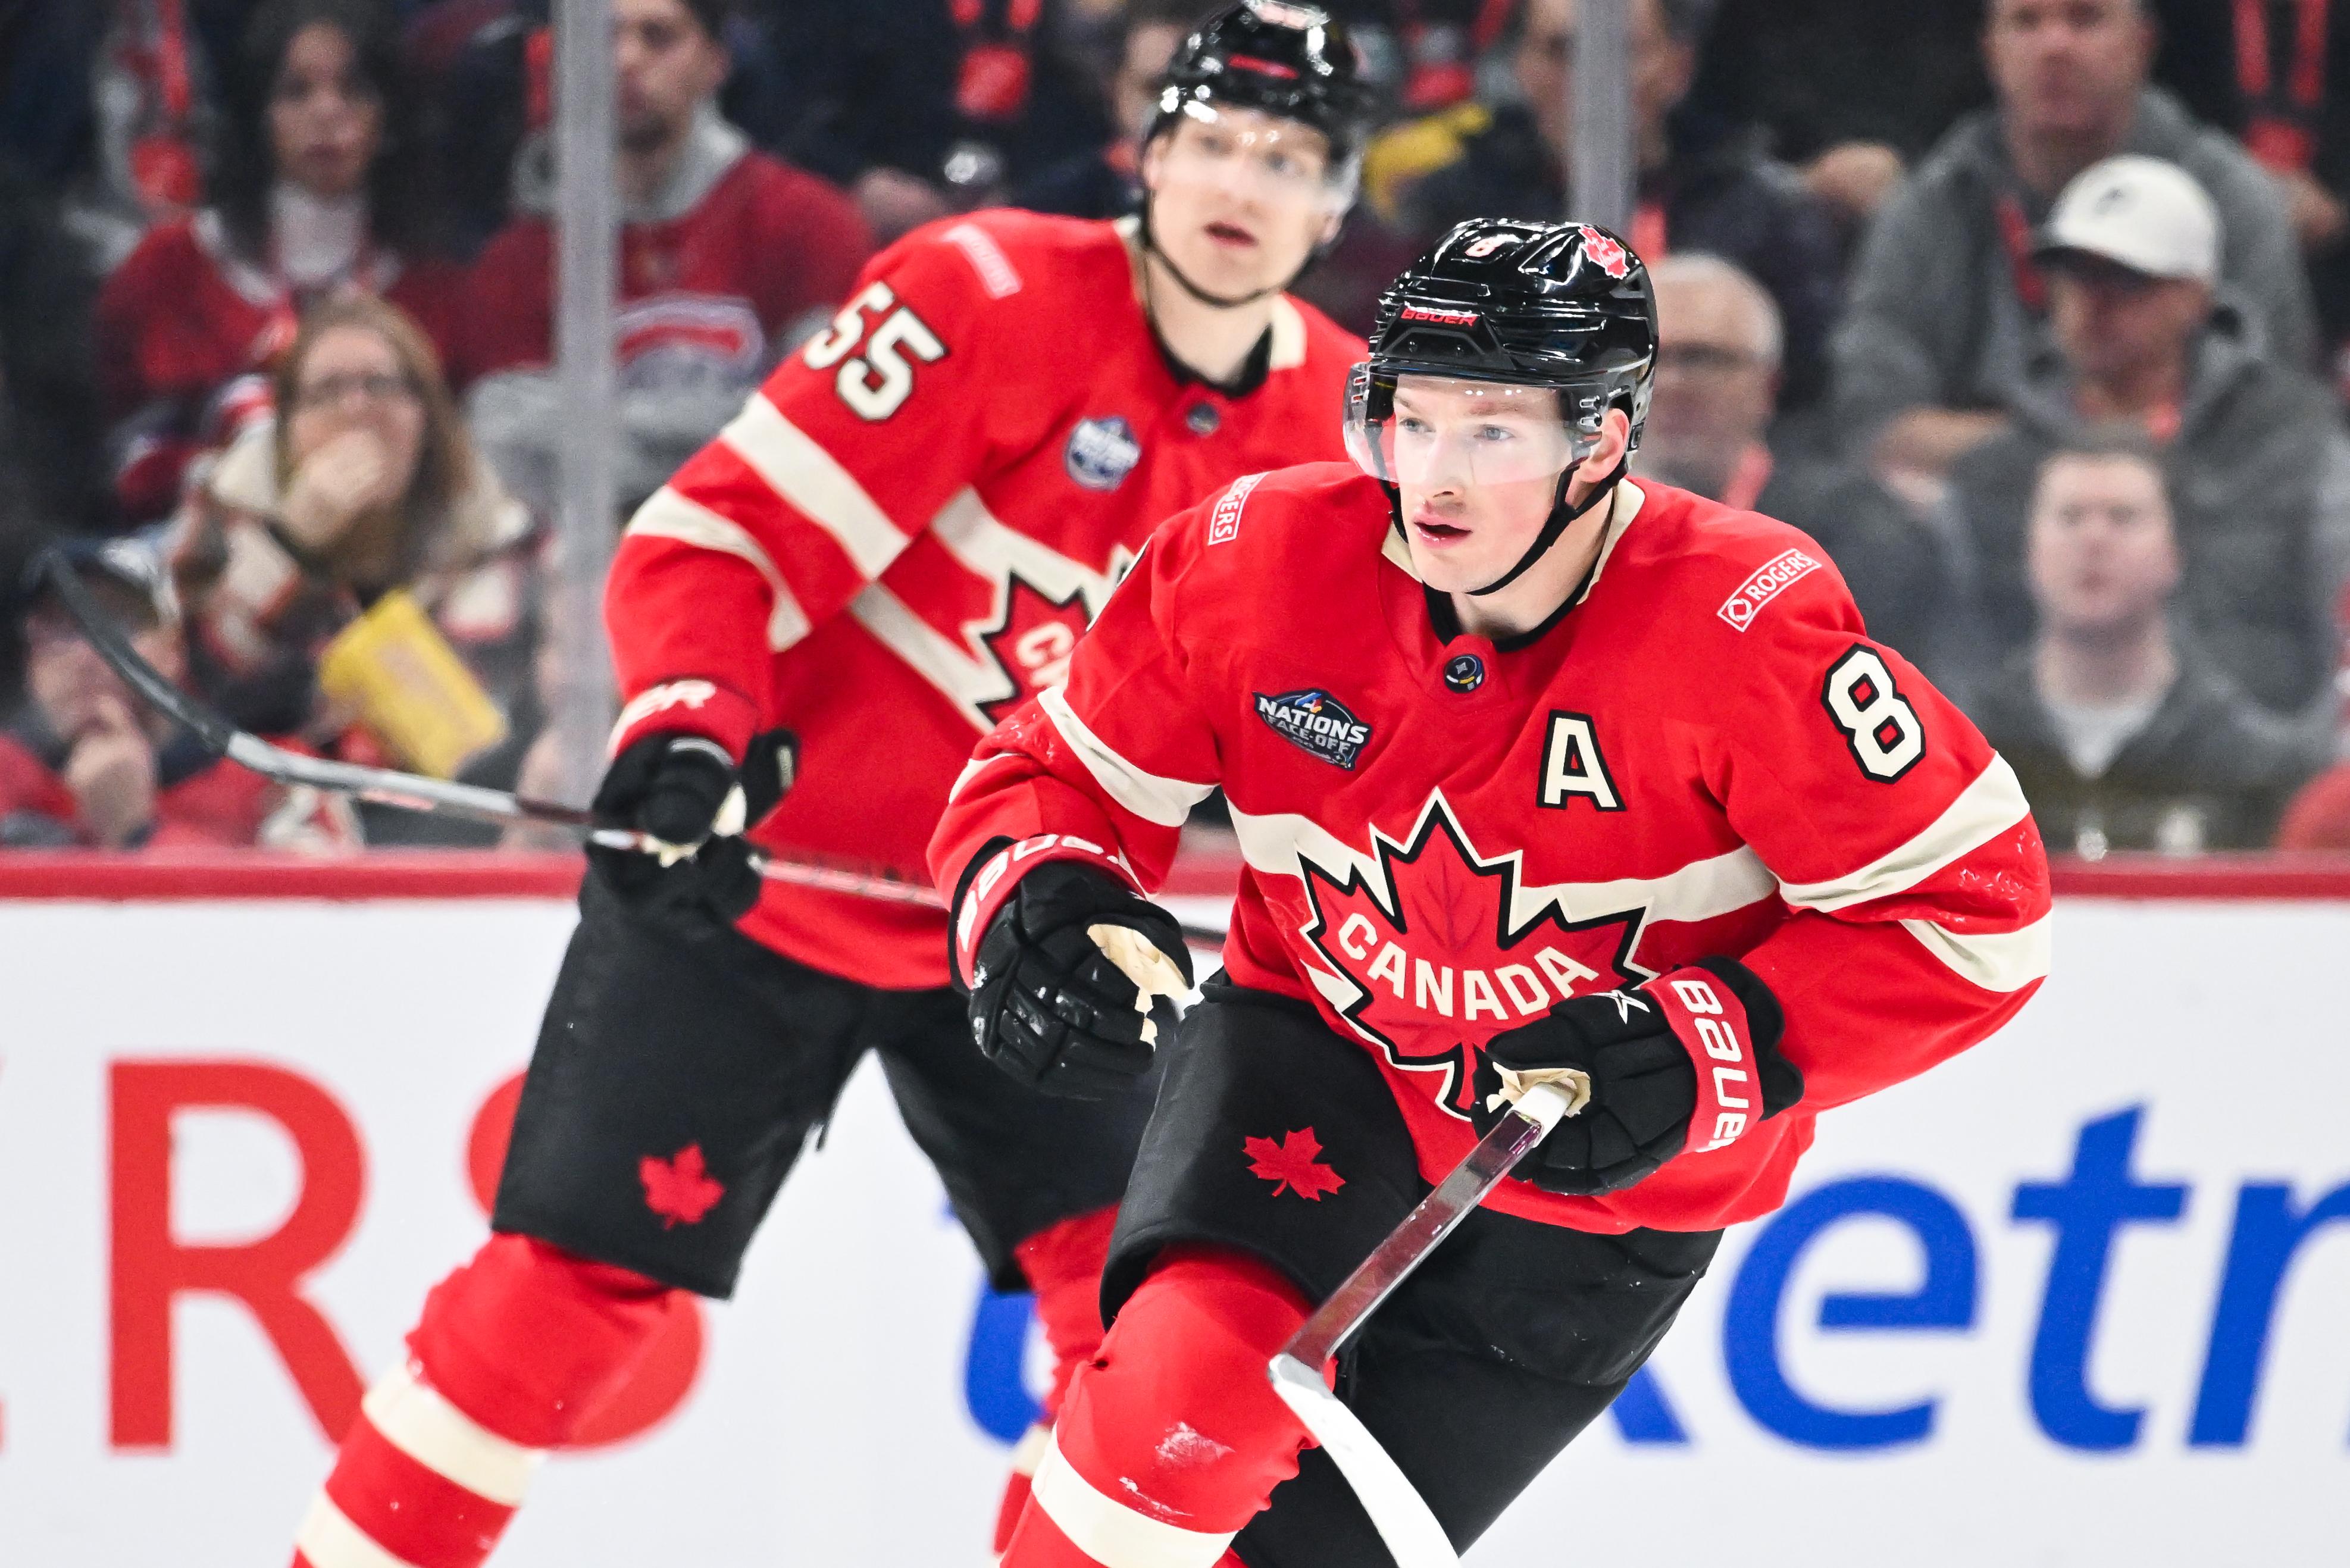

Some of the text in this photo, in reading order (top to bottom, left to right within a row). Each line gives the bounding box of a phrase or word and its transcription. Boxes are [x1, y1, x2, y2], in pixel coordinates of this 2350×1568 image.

[803, 280, 951, 424] 55
[1745, 552, 1813, 601] ROGERS
[1259, 697, 1369, 744] NATIONS
[1268, 715, 1351, 755] FACE-OFF
[1536, 709, 1628, 811] A
[1820, 643, 1926, 784] 8
[1338, 913, 1599, 1021] CANADA
